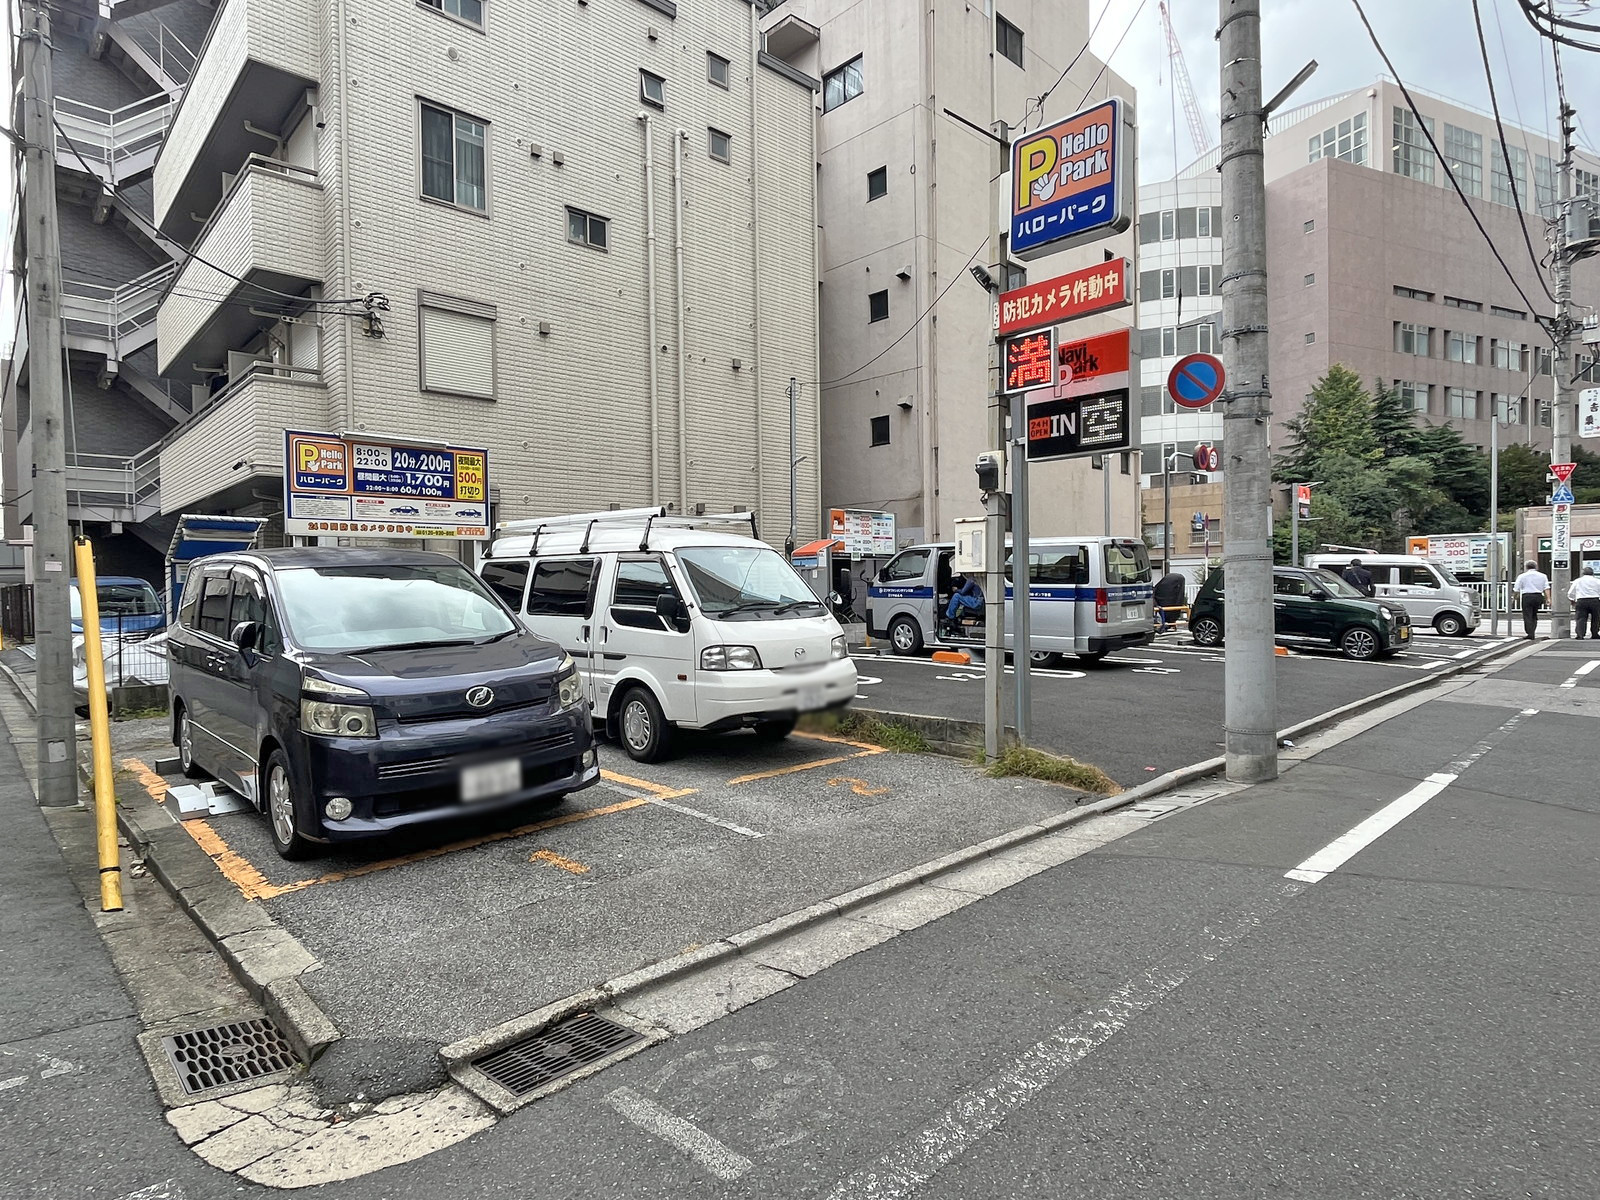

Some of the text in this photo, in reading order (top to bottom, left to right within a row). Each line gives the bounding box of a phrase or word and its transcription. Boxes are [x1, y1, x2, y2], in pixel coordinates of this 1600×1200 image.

[1061, 123, 1109, 160] Hello
[1060, 149, 1108, 187] Park
[1018, 194, 1106, 238] ハローパーク
[1003, 270, 1119, 324] 防犯カメラ作動中
[1009, 335, 1051, 387] 満
[1031, 428, 1048, 438] OPEN
[1050, 412, 1076, 438] IN
[1082, 398, 1122, 444] 空
[320, 449, 343, 460] Hello
[320, 459, 343, 470] Park
[356, 457, 388, 467] 22:00
[299, 476, 343, 485] ハローパーク
[460, 486, 480, 496] 打切り
